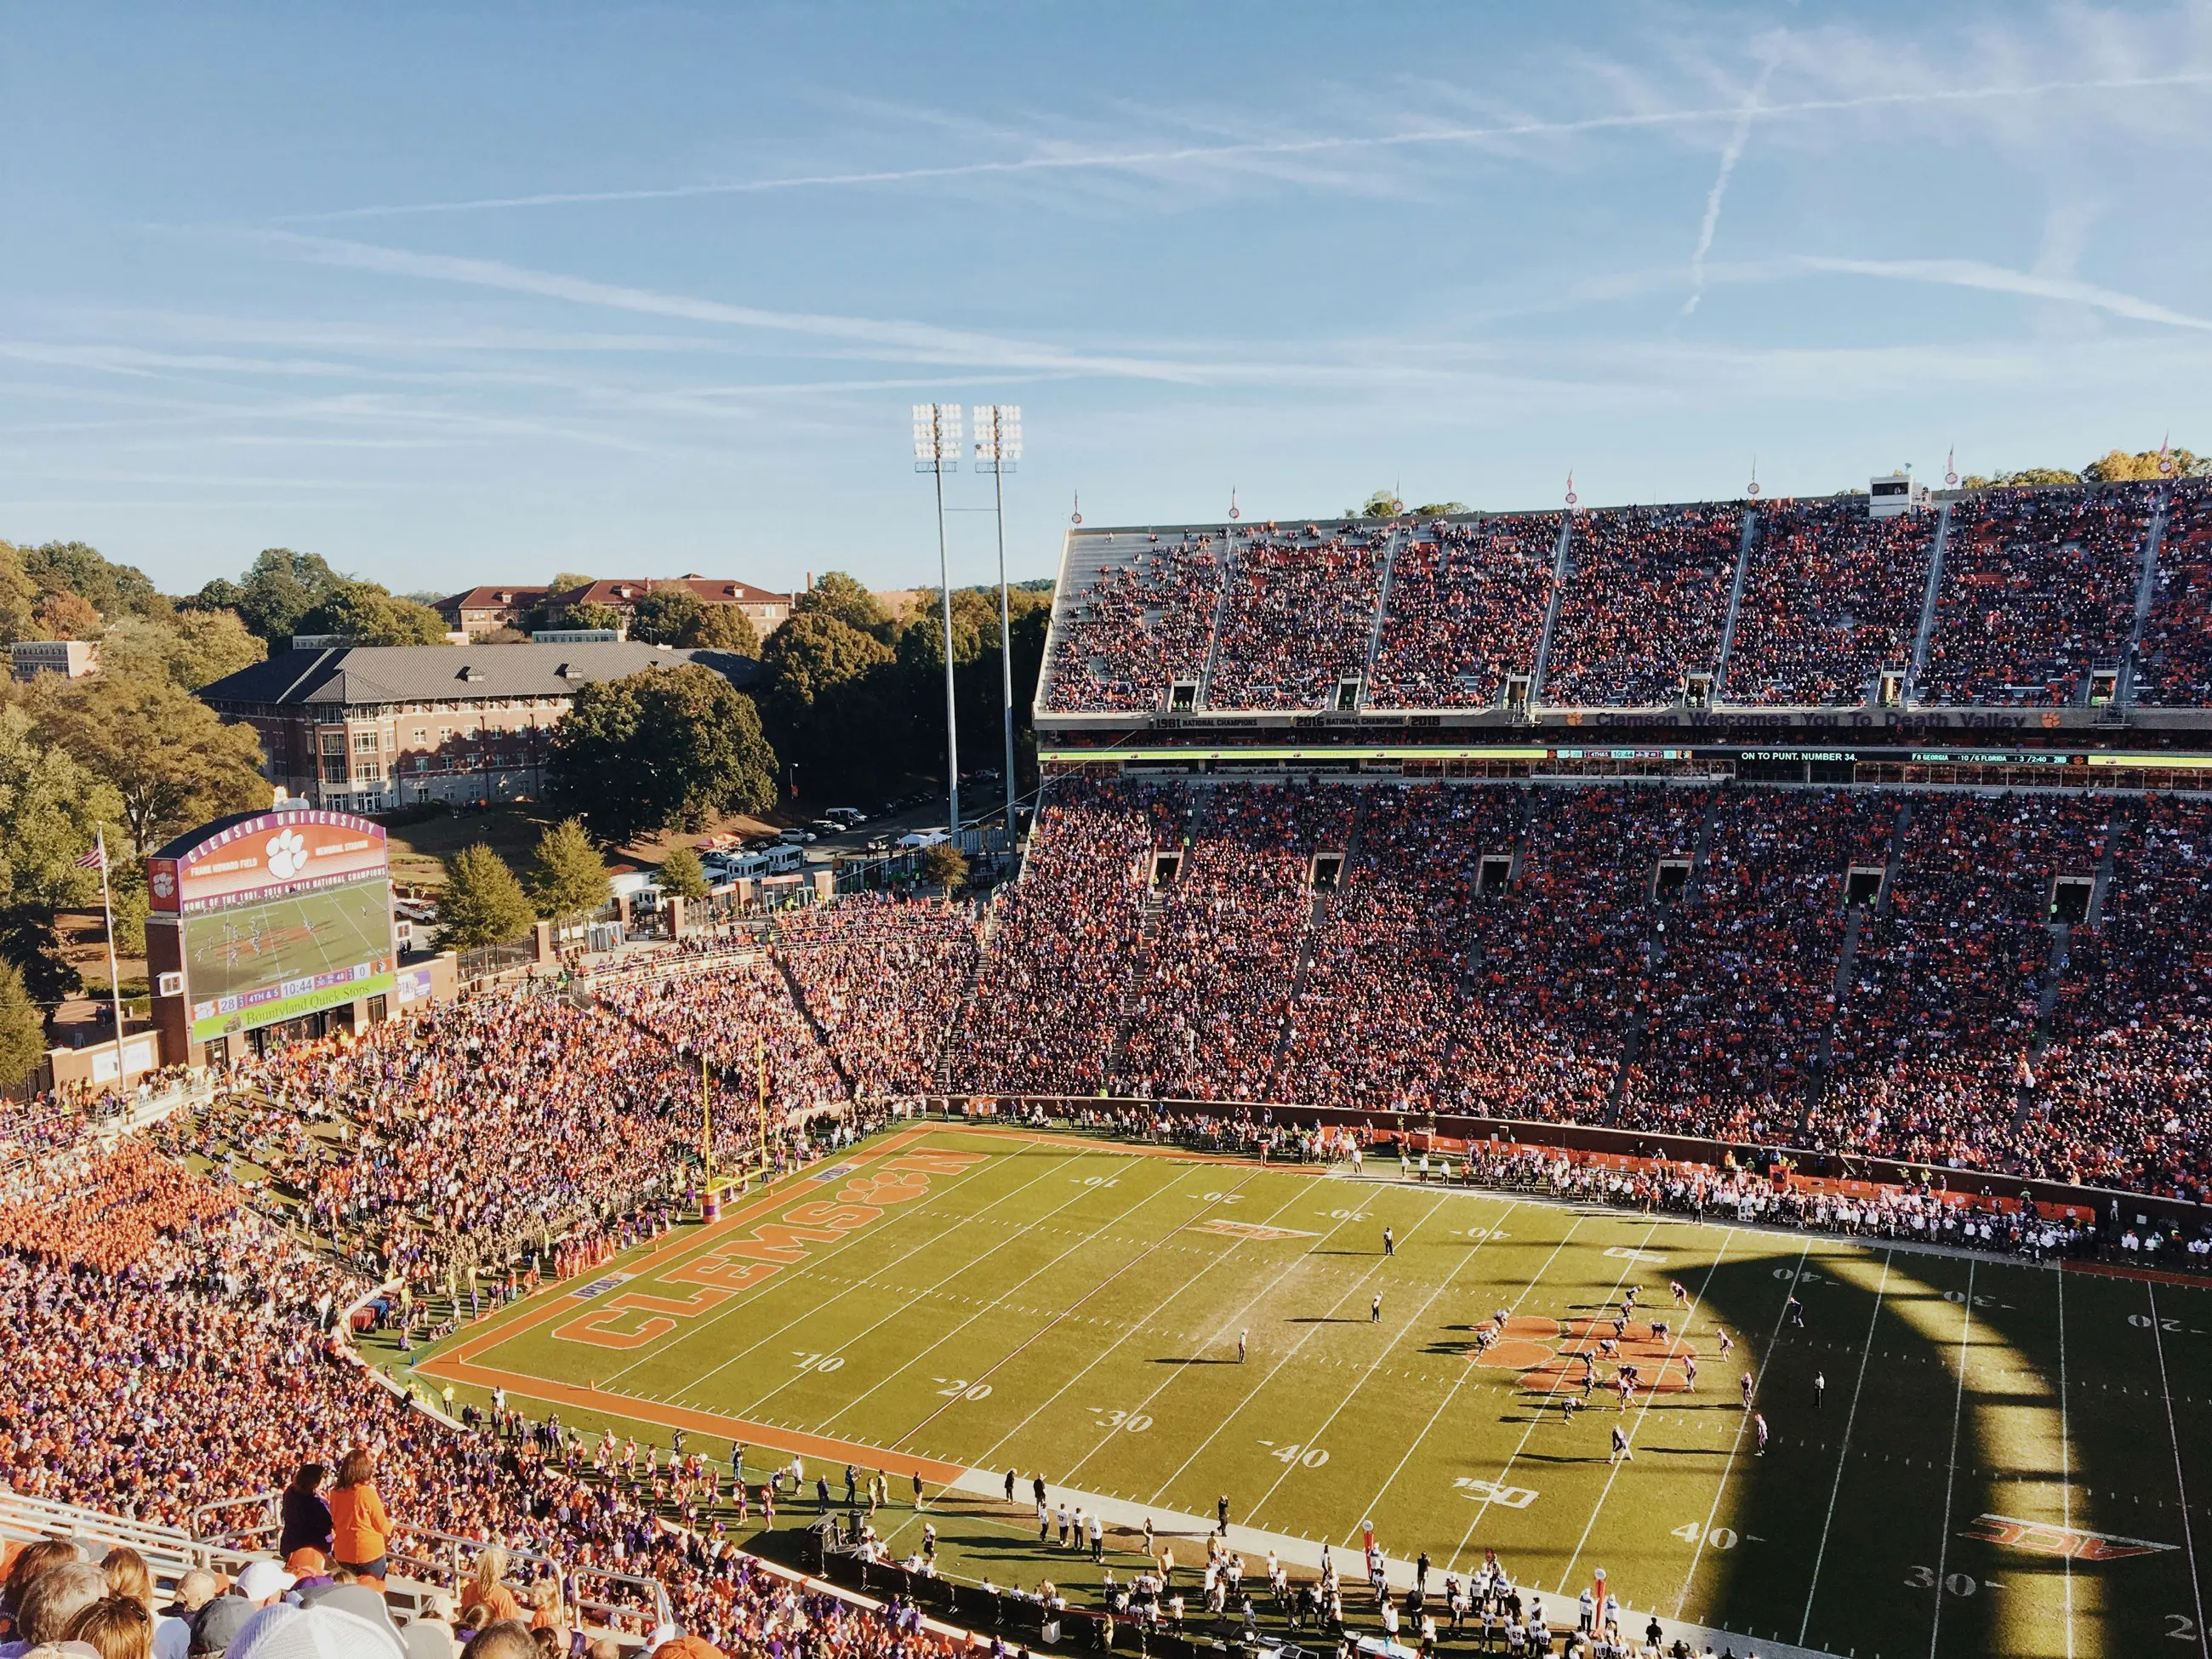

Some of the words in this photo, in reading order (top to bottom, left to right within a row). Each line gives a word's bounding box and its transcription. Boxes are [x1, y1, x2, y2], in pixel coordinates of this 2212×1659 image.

[1217, 718, 1257, 727] CHAMPIONS
[1296, 716, 1324, 727] 2016
[1361, 716, 1403, 725] CHAMPIONS
[1596, 713, 1679, 726] Clemson
[1689, 712, 1791, 726] Welcomes
[1804, 713, 1839, 726] You
[1848, 712, 1873, 726] To
[1884, 712, 1948, 727] Death
[1959, 713, 2027, 727] Valley
[1772, 752, 1799, 761] PUNT.
[1801, 752, 1842, 761] NUMBER
[1844, 753, 1858, 761] 34.
[187, 817, 265, 864] CLEMSON
[276, 810, 375, 835] UNIVERSITY
[190, 864, 212, 876] FRANK
[240, 858, 258, 869] FIELD
[184, 899, 206, 912] HOME
[209, 897, 219, 907] OF
[222, 894, 236, 905] THE
[313, 875, 345, 888] NATIONAL
[347, 867, 385, 881] CHAMPIONS
[360, 966, 365, 977] 0
[283, 979, 312, 996] 10:44
[247, 997, 306, 1025] Bountyland
[310, 990, 340, 1008] Quick
[343, 984, 370, 999] Stops
[248, 993, 265, 1003] 4TH
[265, 990, 272, 999] &
[221, 999, 236, 1012] 28
[1084, 1177, 1120, 1188] 10
[1203, 1192, 1245, 1204] 20
[1331, 1209, 1375, 1222] 30
[1468, 1227, 1512, 1240] 40
[1772, 1268, 1821, 1283] 40
[1943, 1290, 1996, 1308] 30
[2127, 1314, 2181, 1331] 20
[795, 1352, 846, 1374] 10
[936, 1379, 994, 1401] 20
[1095, 1408, 1154, 1433] 30
[1270, 1444, 1331, 1468] 40
[1670, 1521, 1738, 1549] 40
[1903, 1565, 1977, 1597] 30
